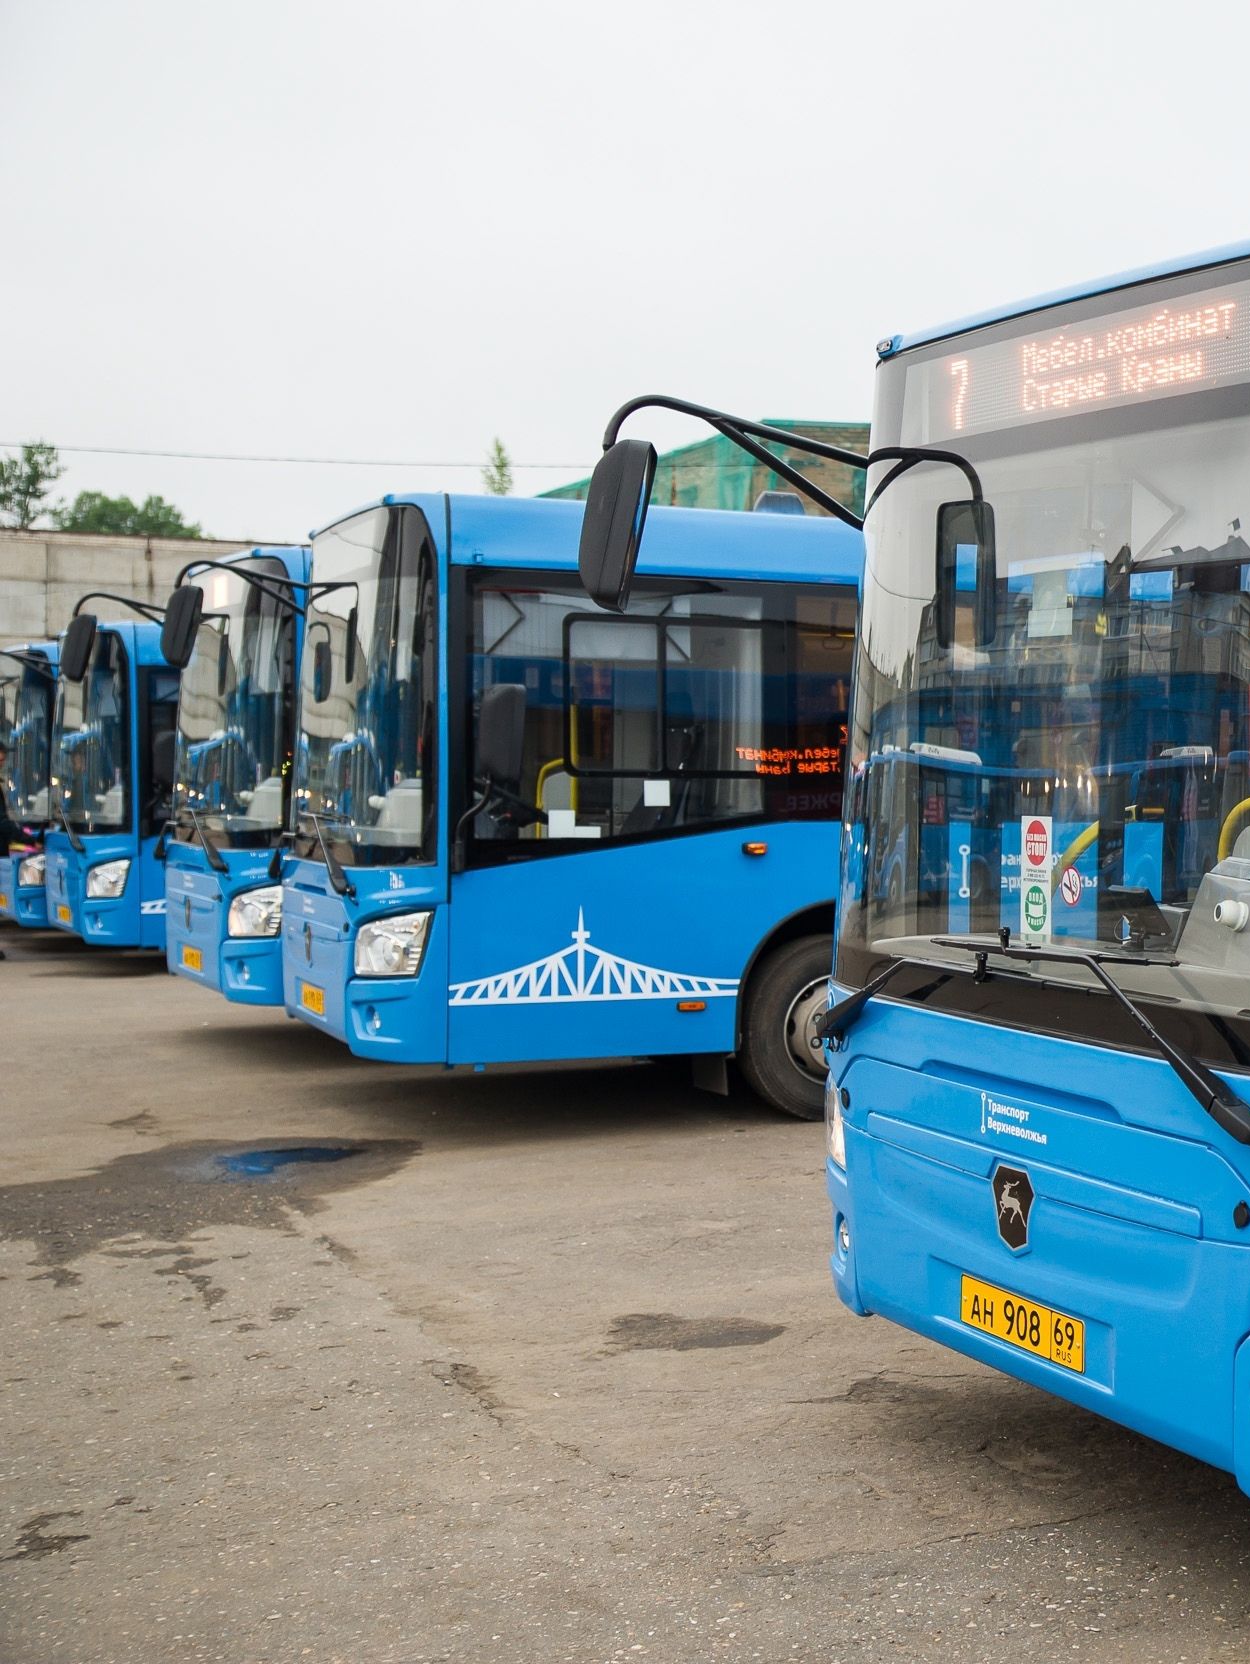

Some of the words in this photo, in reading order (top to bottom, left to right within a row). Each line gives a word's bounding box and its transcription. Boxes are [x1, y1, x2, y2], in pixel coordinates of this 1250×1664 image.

[950, 358, 968, 430] 7
[1022, 373, 1105, 411] Старые
[1121, 351, 1202, 393] Краны
[987, 1098, 1030, 1123] Транспорт
[987, 1116, 1048, 1145] Верхневолжья
[970, 1294, 994, 1329] АН
[1003, 1299, 1041, 1347] 908
[1053, 1317, 1075, 1351] 69
[1055, 1347, 1073, 1364] RUS
